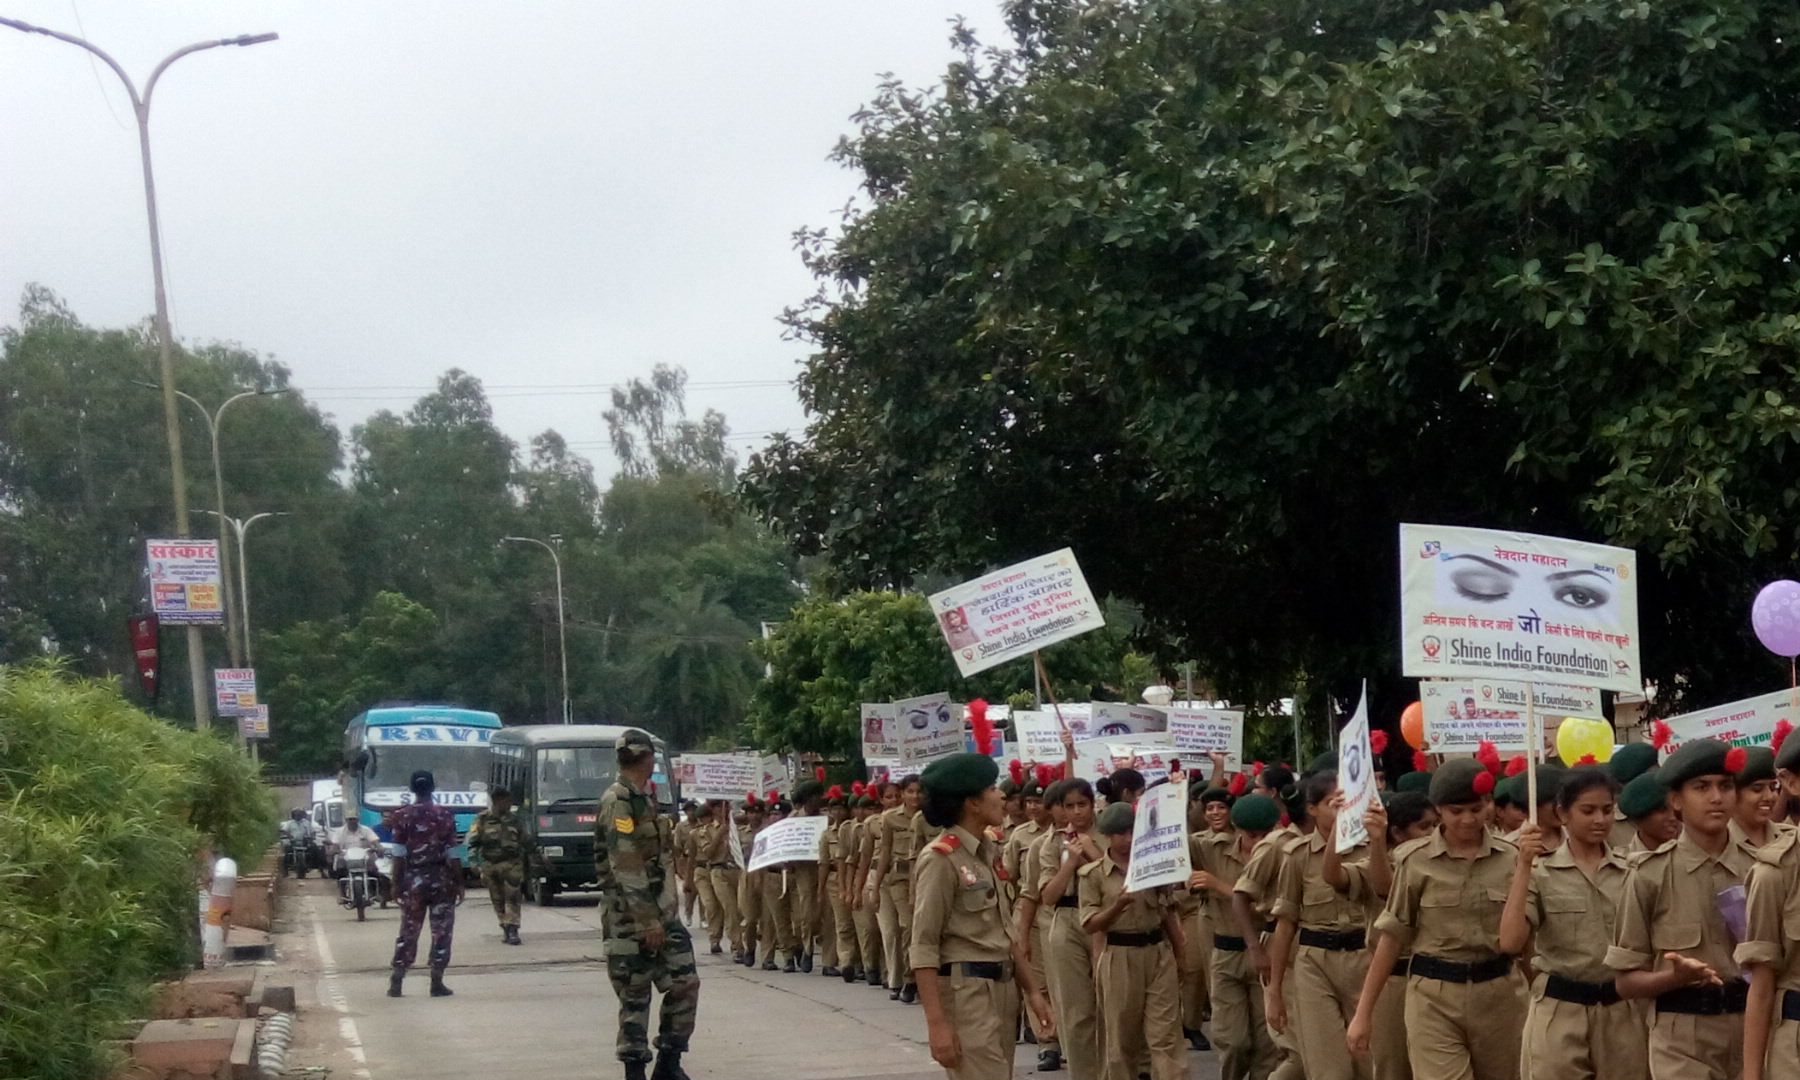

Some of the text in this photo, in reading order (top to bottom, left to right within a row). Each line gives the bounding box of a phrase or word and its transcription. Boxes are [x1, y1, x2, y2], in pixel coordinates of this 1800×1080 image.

[150, 541, 216, 559] संस्कार
[1494, 545, 1568, 568] नेत्रदान महादान
[1517, 608, 1541, 634] जो
[978, 640, 1002, 655] Shine
[1004, 630, 1025, 646] India
[1027, 615, 1074, 637] Foundation
[1451, 638, 1492, 660] Shine
[1497, 641, 1531, 664] India
[1537, 646, 1608, 672] Foundation
[1497, 687, 1519, 701] Shine
[1541, 692, 1583, 708] Foundation
[1444, 732, 1464, 742] Shine
[1485, 732, 1524, 742] Foundation
[1731, 734, 1752, 748] hat
[1753, 731, 1772, 747] you
[400, 793, 477, 806] SNJAY
